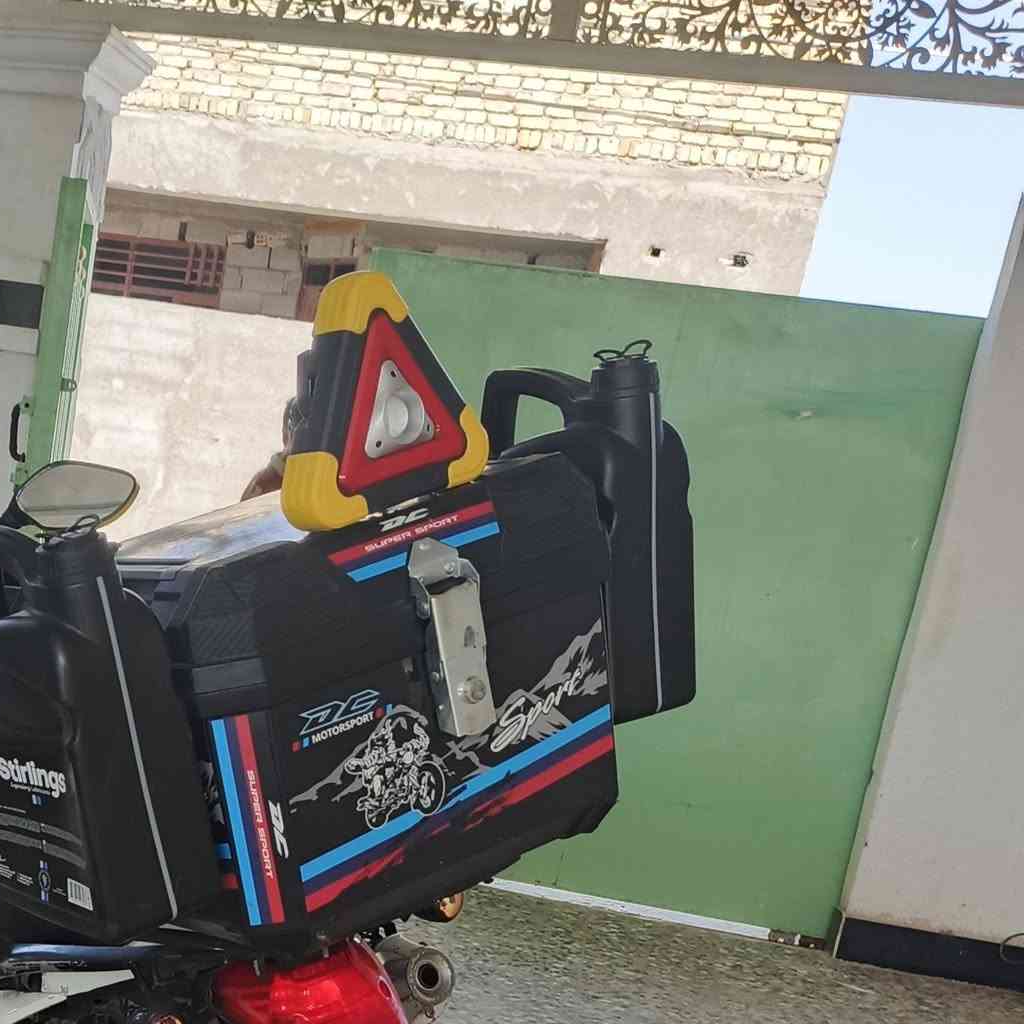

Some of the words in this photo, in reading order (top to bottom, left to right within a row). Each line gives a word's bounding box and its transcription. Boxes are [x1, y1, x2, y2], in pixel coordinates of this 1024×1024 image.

[364, 529, 412, 552] SUPER
[413, 514, 460, 539] SPORT
[311, 711, 375, 745] MOTORSPORT
[490, 669, 587, 752] Sport
[246, 769, 264, 823] SUPER
[258, 827, 275, 879] SPORT
